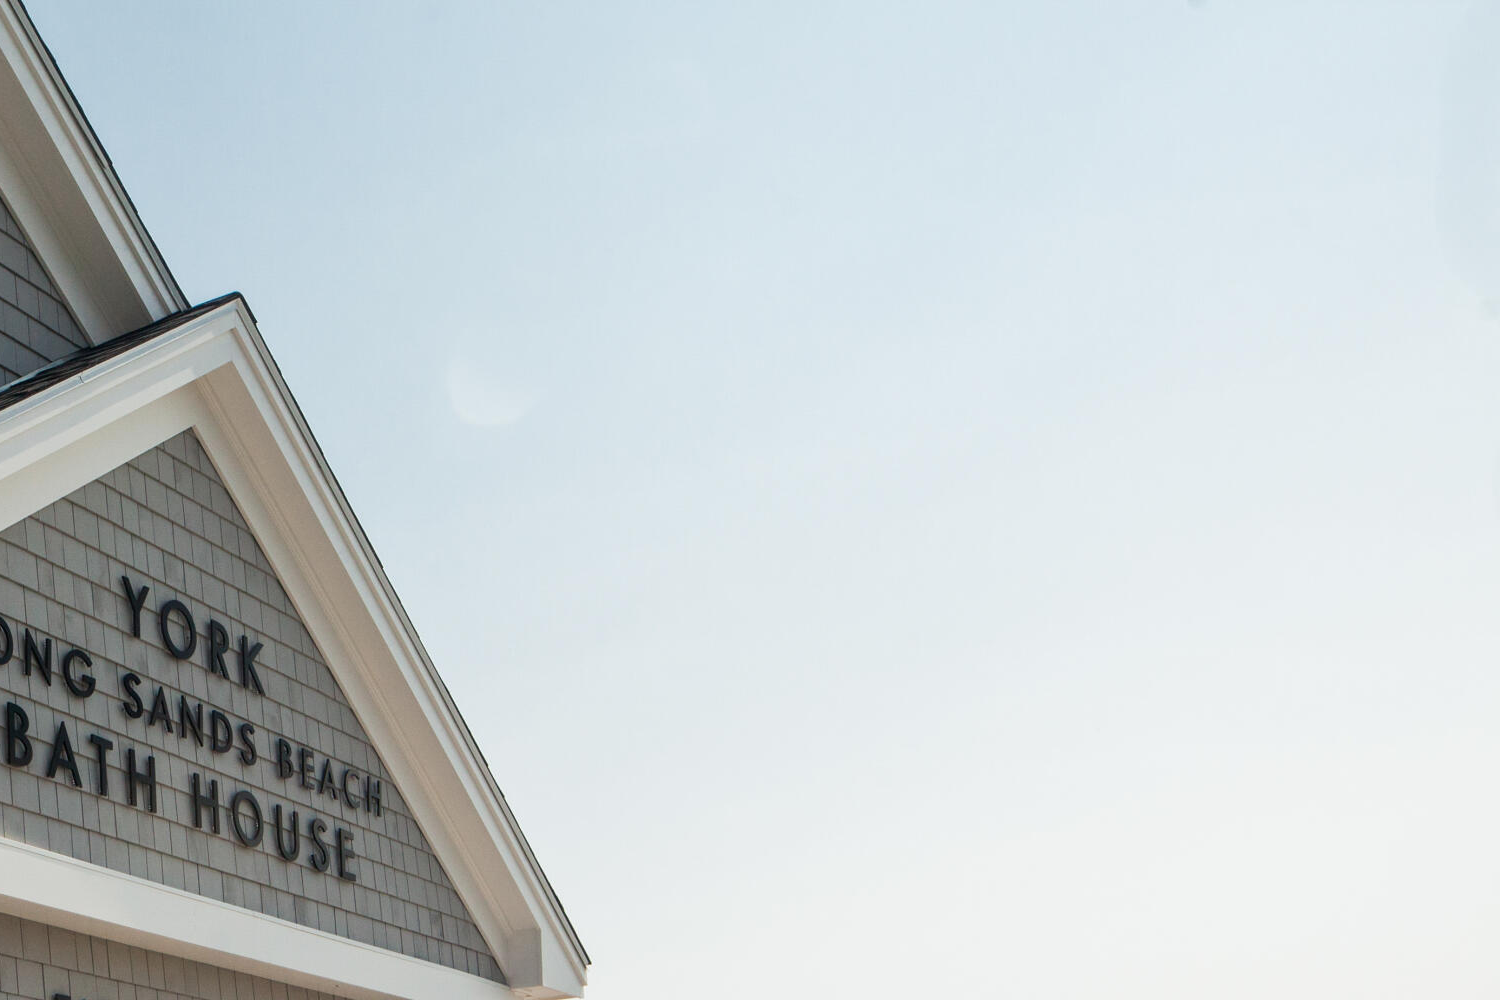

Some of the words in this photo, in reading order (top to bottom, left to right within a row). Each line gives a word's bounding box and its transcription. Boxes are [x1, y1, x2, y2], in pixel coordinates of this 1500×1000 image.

[121, 575, 266, 696] YORK
[6, 701, 157, 813] BATH
[193, 772, 357, 882] HOUSE
[122, 672, 257, 766] SANDS
[278, 738, 382, 817] BEACH
